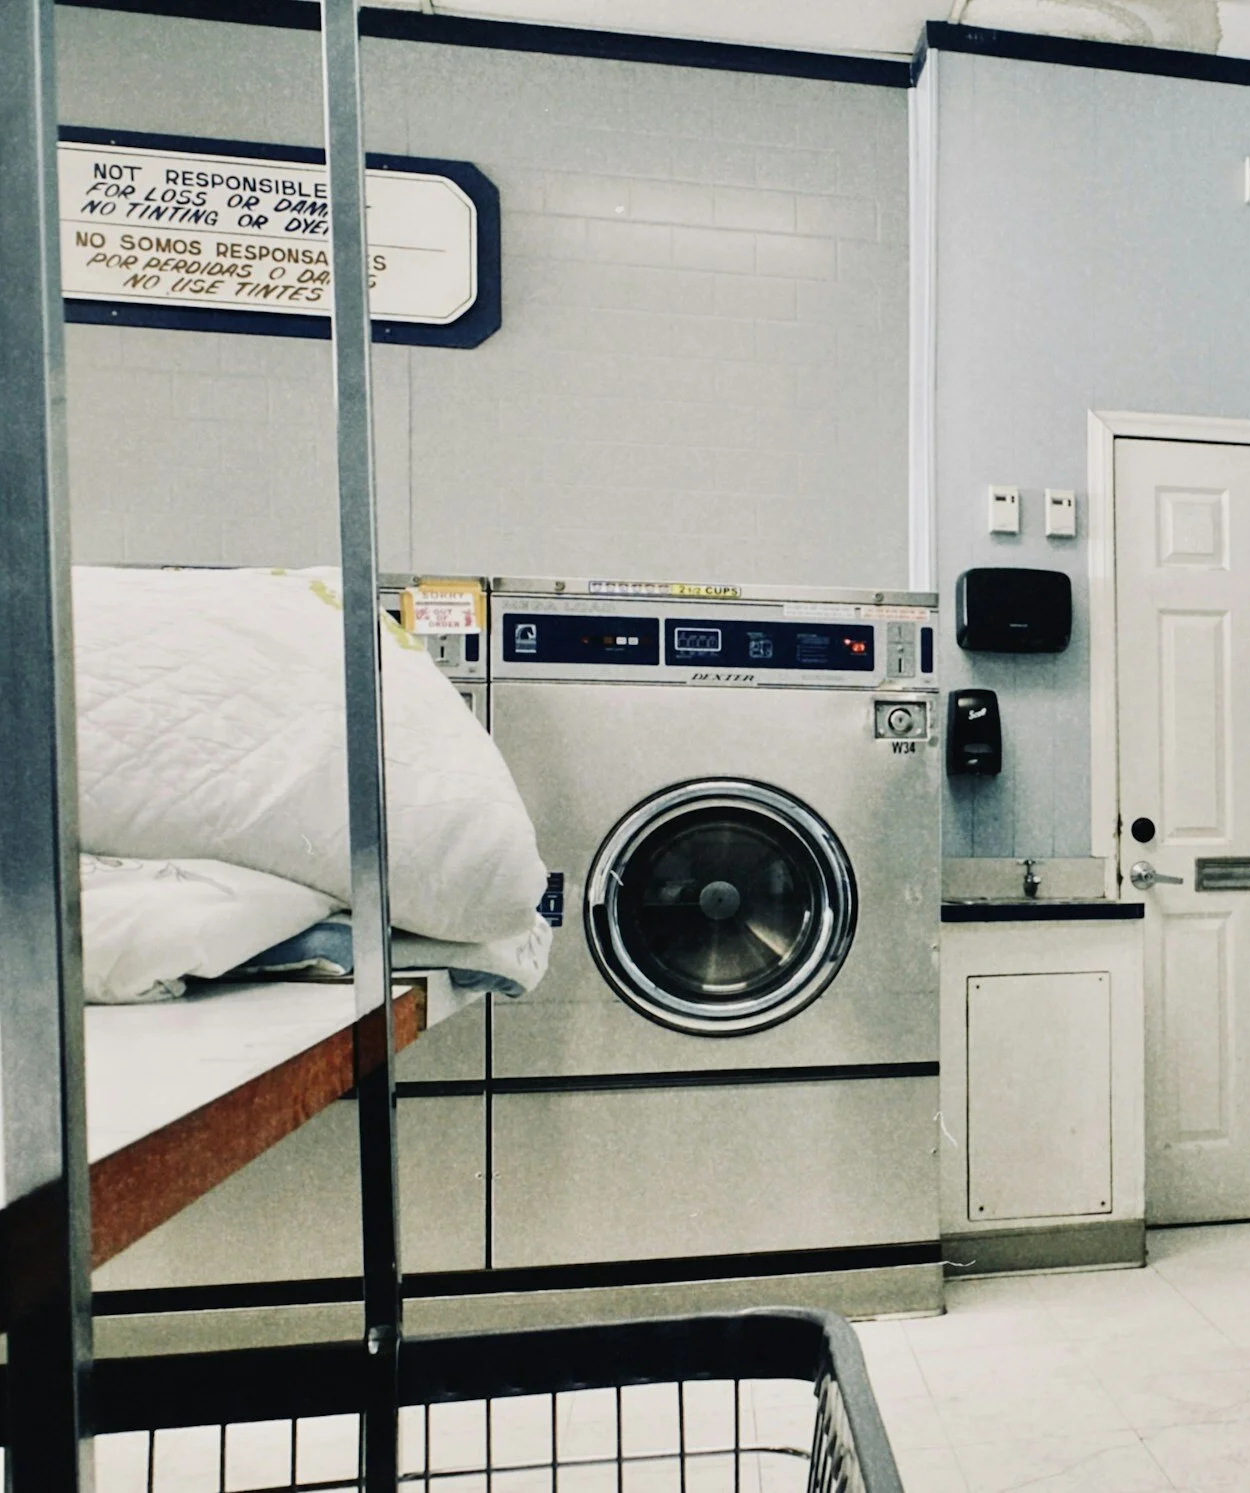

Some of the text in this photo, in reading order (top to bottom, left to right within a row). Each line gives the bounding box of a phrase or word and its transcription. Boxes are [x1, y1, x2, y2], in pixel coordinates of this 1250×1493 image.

[94, 163, 328, 199] NOT RESPONSIBLE
[85, 182, 135, 199] FOR
[145, 187, 207, 206] LOSS
[227, 194, 260, 212] OR
[81, 200, 116, 216] NO
[126, 203, 219, 226] TINTING
[238, 214, 269, 230] OR
[75, 232, 106, 248] NO
[120, 235, 202, 256] SOMOS
[86, 253, 138, 270] POR
[142, 257, 253, 279] PERDIDAS
[269, 266, 287, 281] O
[123, 273, 324, 302] NO USE TINTES
[705, 586, 738, 596] CUPS
[691, 672, 755, 682] DEXTER
[892, 741, 916, 754] W34
